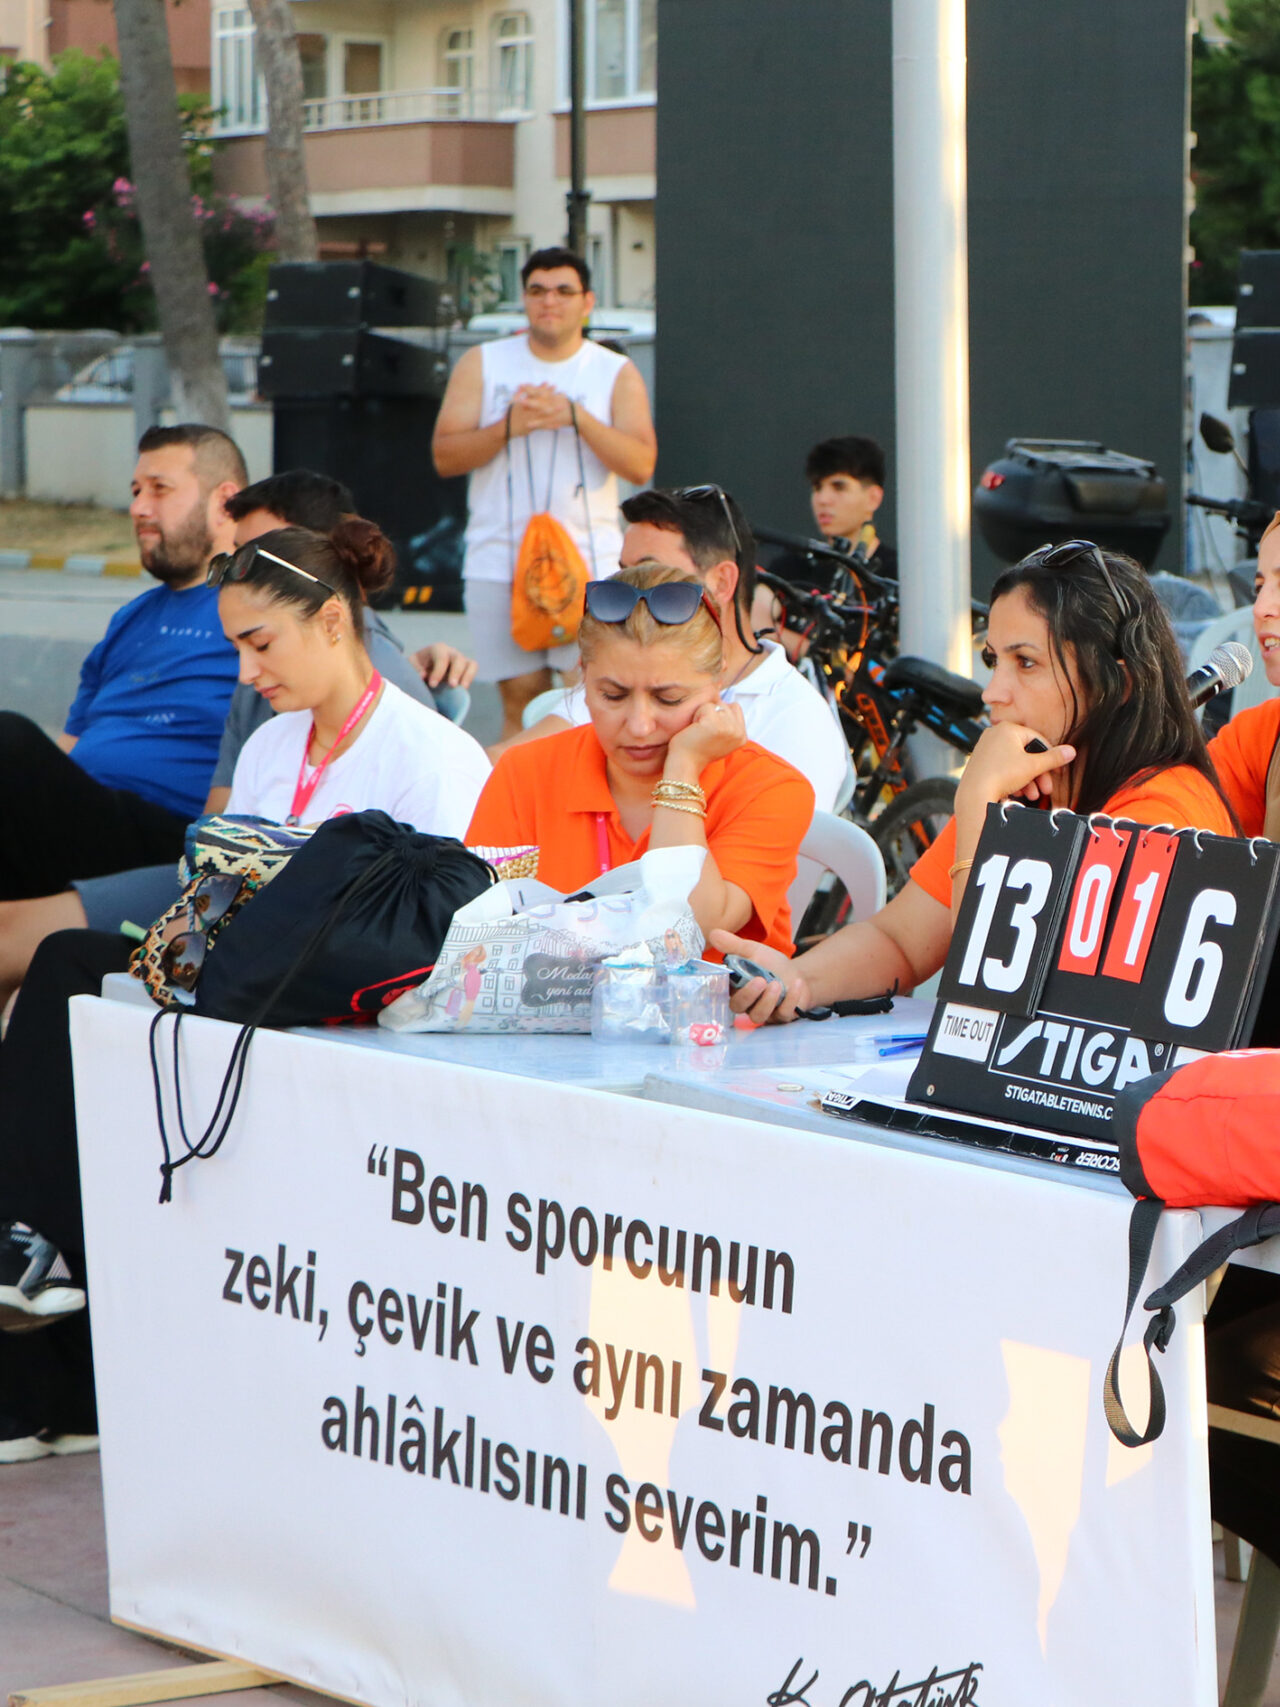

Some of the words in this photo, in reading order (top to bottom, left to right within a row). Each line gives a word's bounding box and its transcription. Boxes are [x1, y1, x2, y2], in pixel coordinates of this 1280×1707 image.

[574, 979, 593, 996] ad
[959, 854, 1053, 993] 13
[1069, 863, 1113, 959] 0
[1123, 871, 1161, 966] 1
[1164, 888, 1237, 1028] 6
[945, 1014, 970, 1039] TIME
[970, 1021, 994, 1044] OUT
[1004, 1084, 1114, 1121] STIGATABLETENNIS.C
[367, 1143, 488, 1242] “Ben
[505, 1192, 795, 1315] sporcunun
[222, 1243, 328, 1342] zeki,
[347, 1280, 481, 1366] çevik
[496, 1315, 555, 1384] ve
[572, 1337, 682, 1421] aynı
[698, 1368, 972, 1496] zamanda
[321, 1385, 587, 1521] ahlâklısını
[604, 1473, 872, 1597] severim.”
